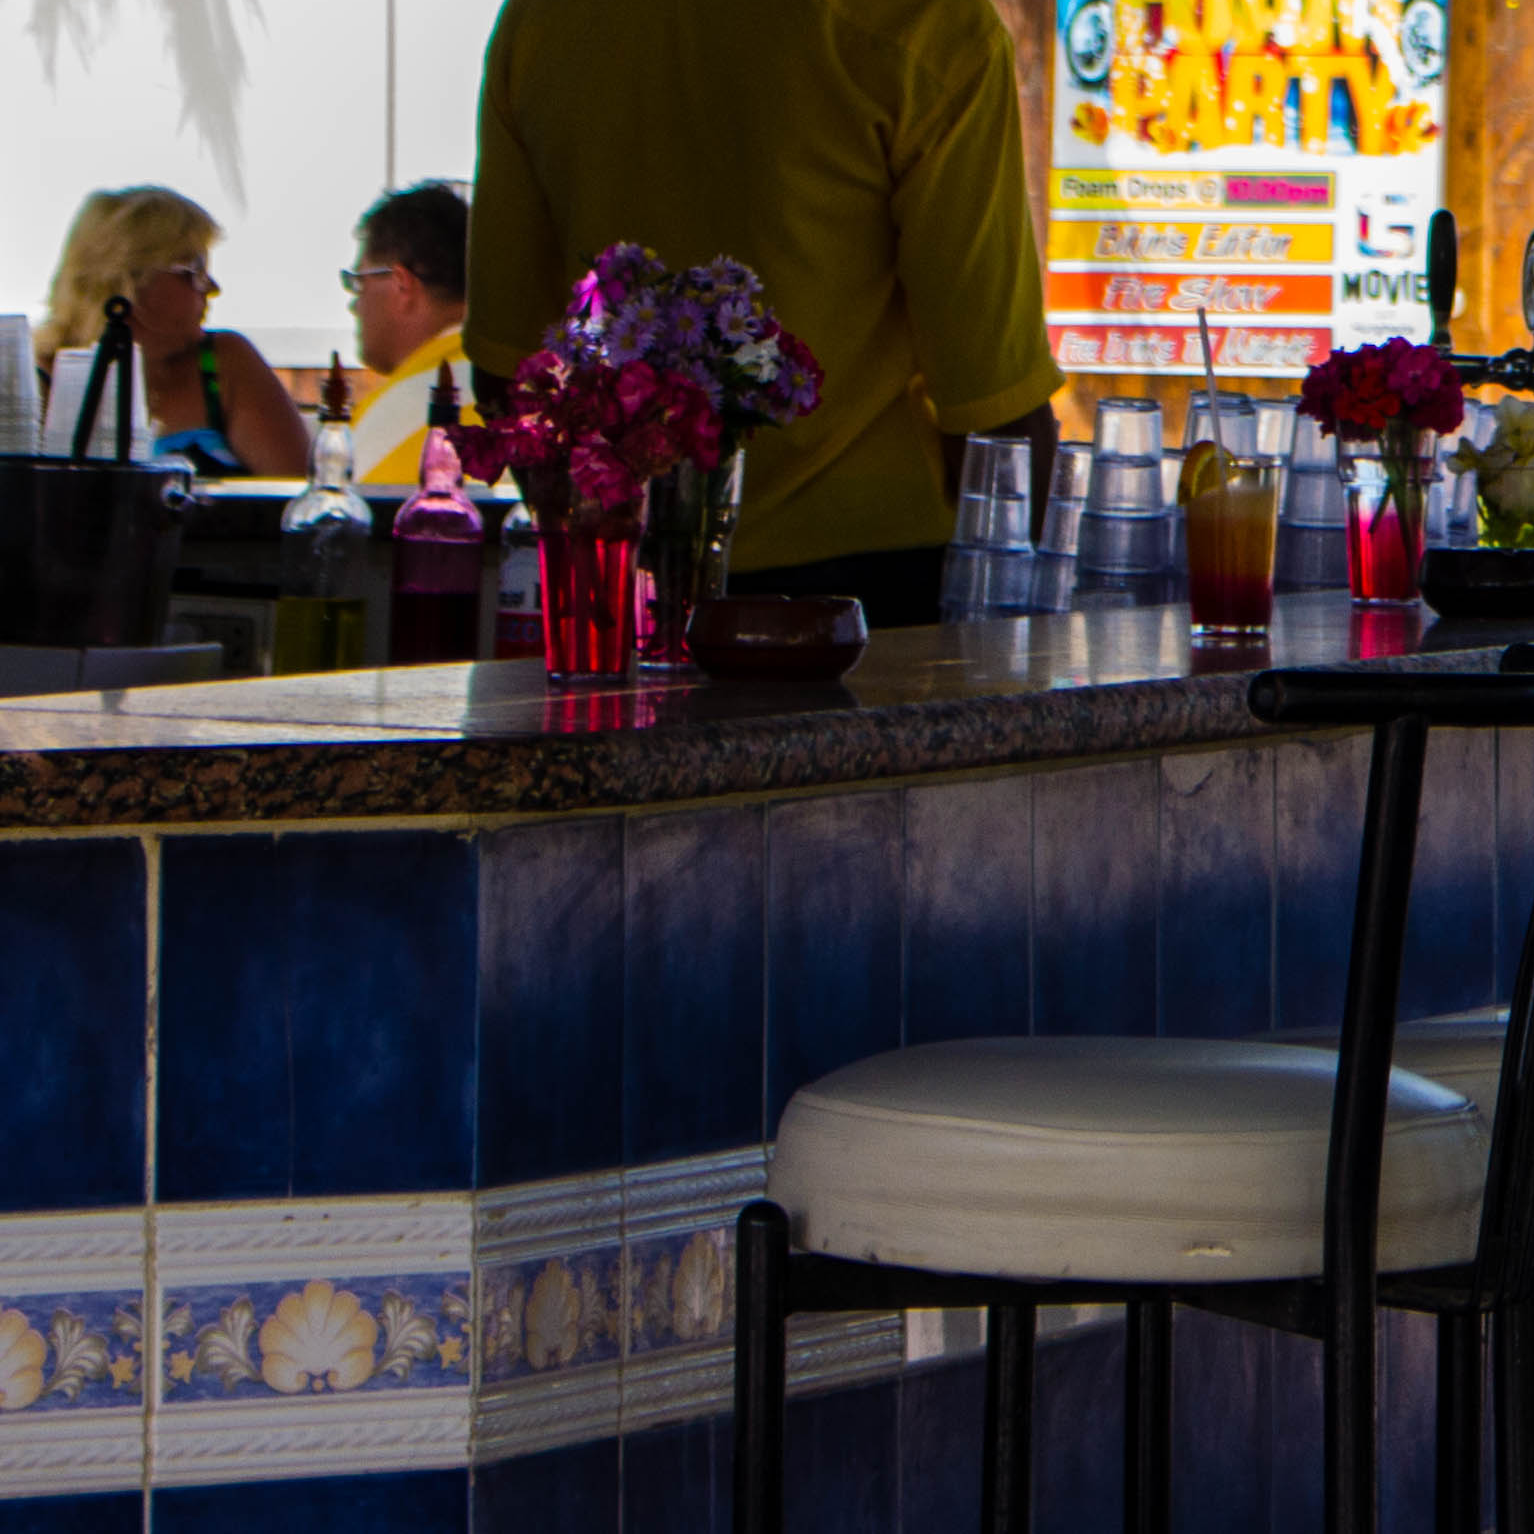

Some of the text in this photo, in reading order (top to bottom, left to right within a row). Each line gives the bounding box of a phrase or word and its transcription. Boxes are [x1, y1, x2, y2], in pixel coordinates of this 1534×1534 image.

[1110, 53, 1398, 155] PARTY
[1062, 177, 1118, 200] Foam
[1127, 178, 1188, 205] Drops
[1342, 269, 1429, 305] MOVIE
